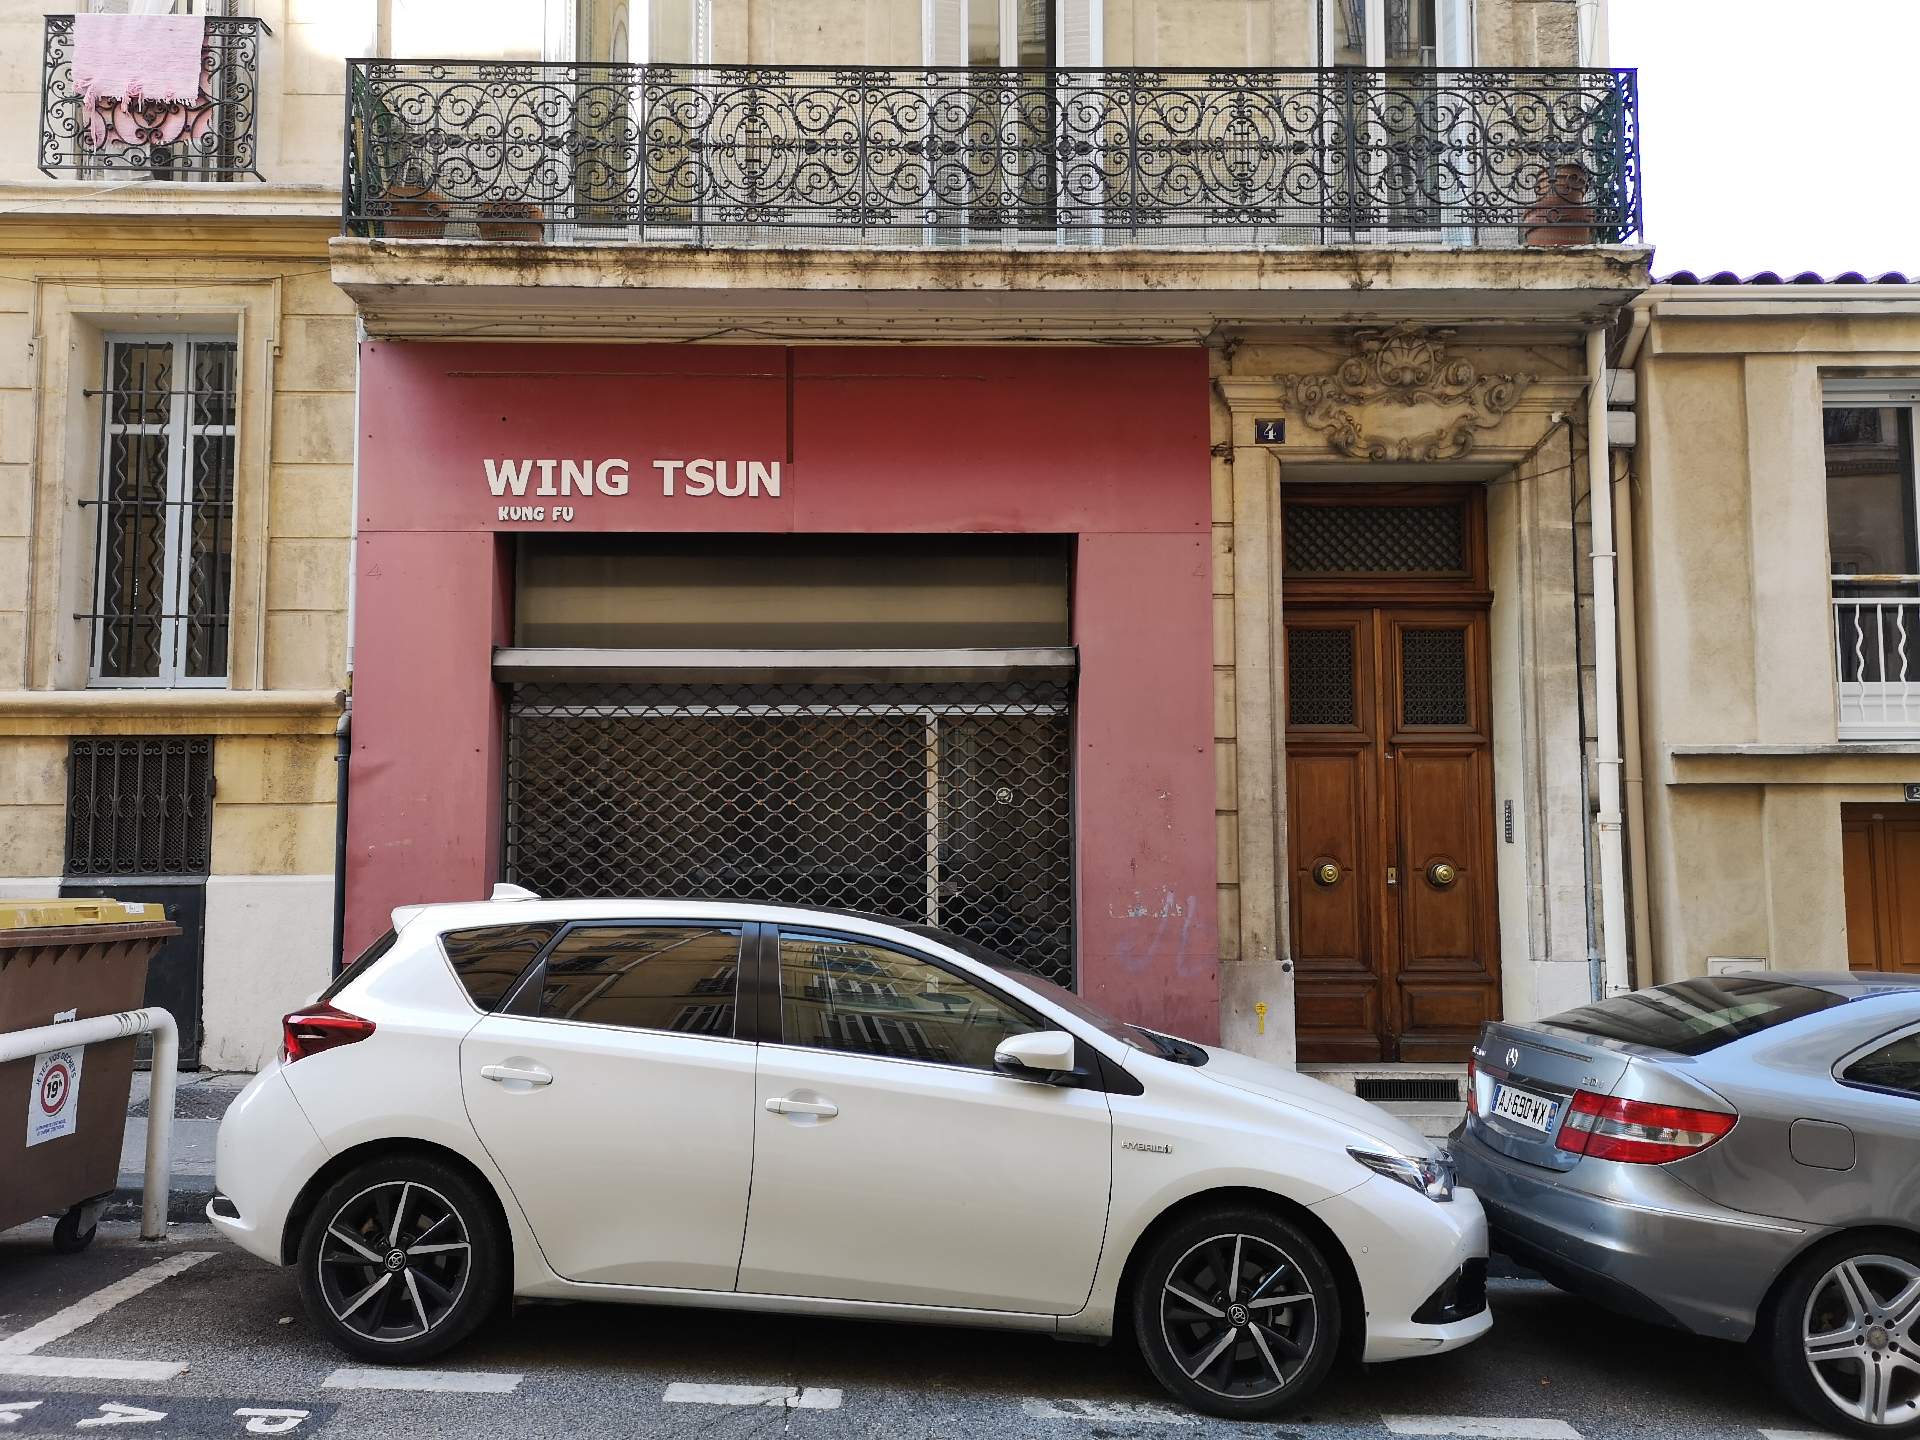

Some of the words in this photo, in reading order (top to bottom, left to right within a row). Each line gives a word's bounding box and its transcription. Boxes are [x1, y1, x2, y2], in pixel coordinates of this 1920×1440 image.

[1263, 422, 1277, 440] 4
[483, 458, 629, 496] WING
[653, 458, 781, 498] TSUN
[498, 505, 545, 521] KUNG
[552, 506, 574, 521] FU
[1121, 1140, 1165, 1153] HYBRID
